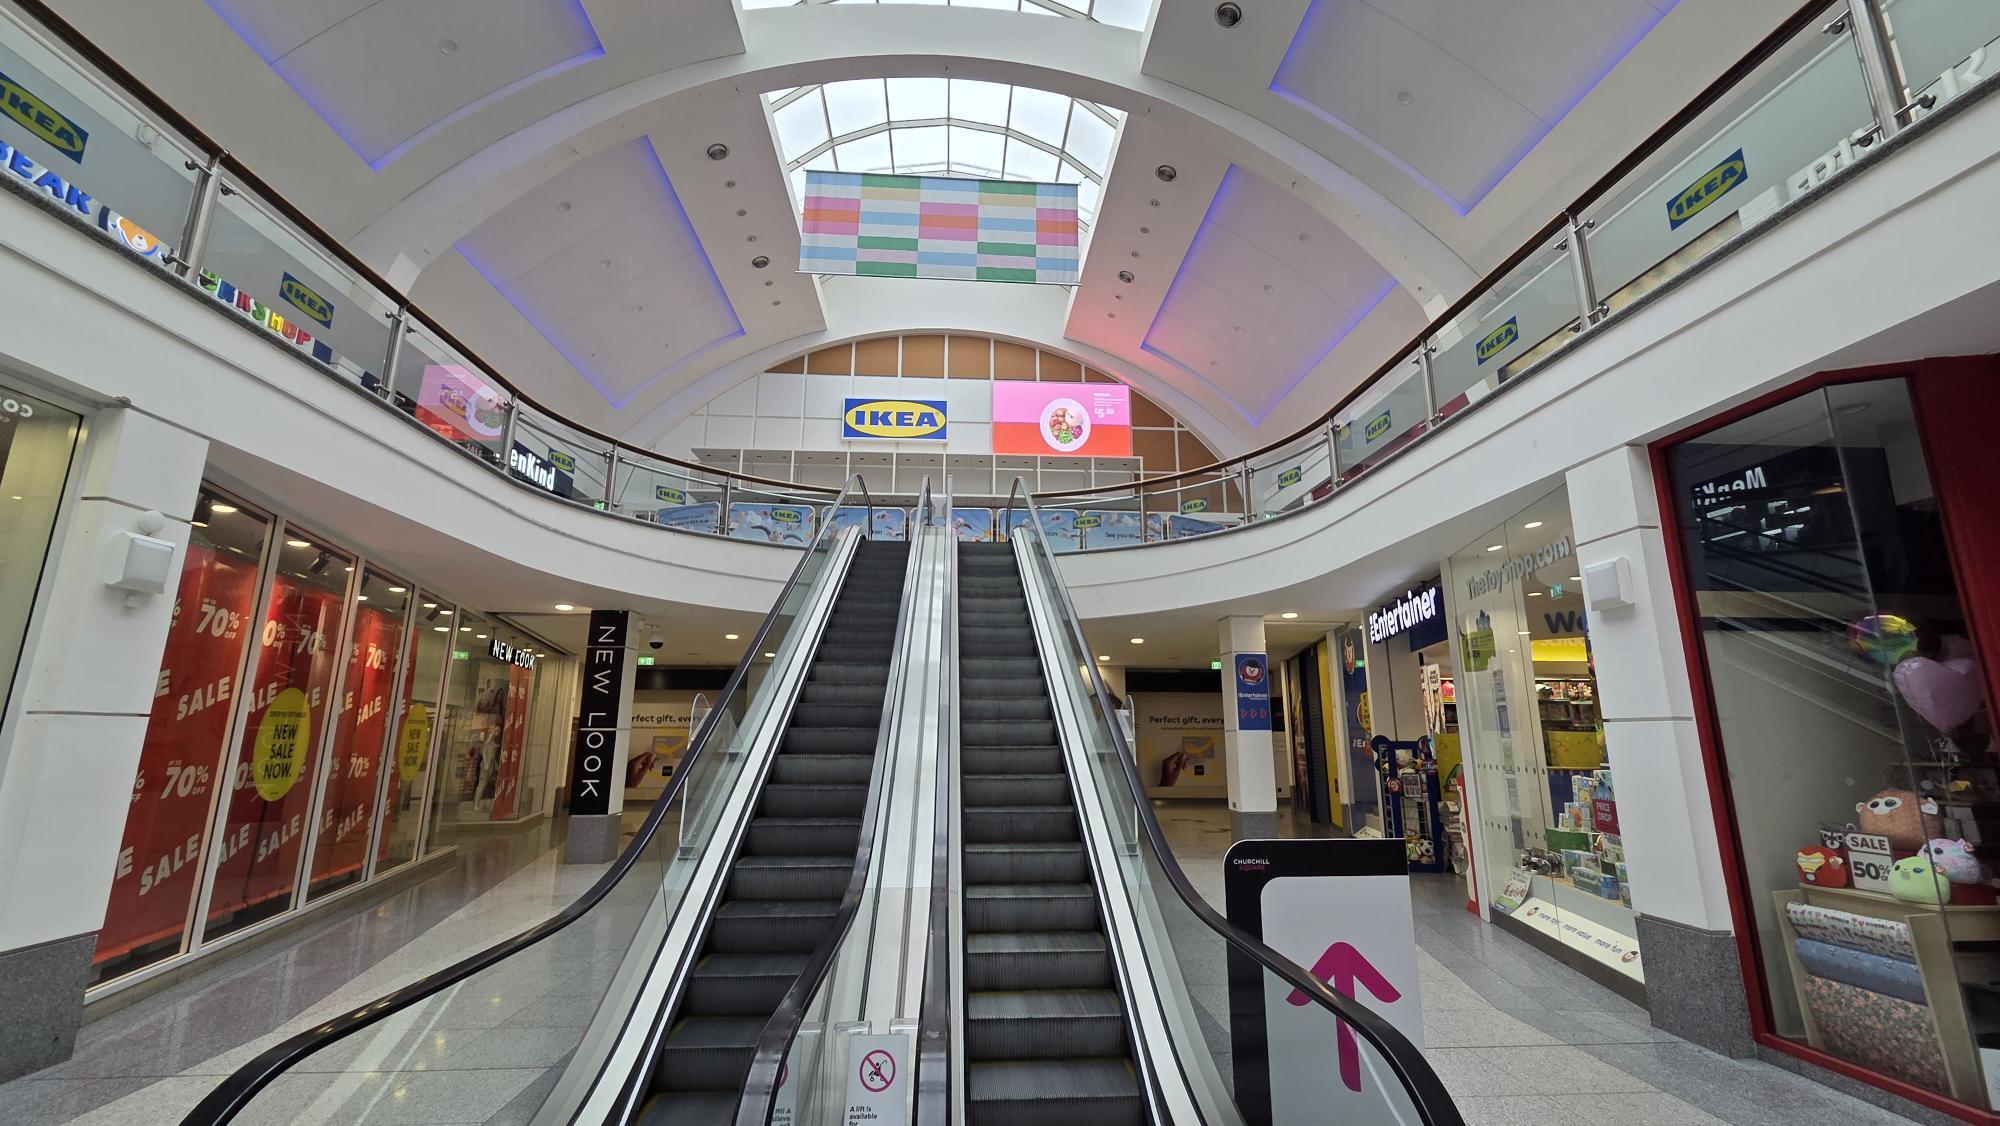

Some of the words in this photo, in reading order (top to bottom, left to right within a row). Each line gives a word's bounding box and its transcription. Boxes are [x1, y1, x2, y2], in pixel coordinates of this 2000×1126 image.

[1674, 167, 1739, 218] IKEA
[286, 282, 328, 319] IKEA
[1480, 323, 1516, 356] IKEA
[854, 410, 938, 427] IKEA
[1367, 416, 1390, 438] IKEA
[495, 447, 556, 492] enKind
[551, 453, 573, 470] IKEA
[1280, 470, 1300, 484] IKEA
[659, 489, 684, 503] IKEA
[1182, 501, 1206, 513] IKEA
[774, 511, 800, 522] IKEA
[1076, 517, 1099, 527] IKEA
[196, 604, 240, 638] 70%
[1373, 586, 1436, 642] Entertainer
[493, 639, 513, 662] NEW
[515, 650, 536, 670] LOOK
[592, 625, 616, 694] NEW
[177, 675, 230, 721] SALE
[1149, 715, 1180, 724] Perfect
[273, 724, 298, 741] NEW
[409, 728, 421, 739] NEW
[269, 743, 294, 760] SALE
[406, 743, 420, 754] SALE
[580, 712, 607, 798] LOOK
[348, 756, 370, 779] 70%
[160, 765, 209, 800] 70%
[192, 786, 207, 796] OFF
[336, 803, 364, 843] SALE
[218, 823, 250, 869] ALE
[257, 814, 300, 864] SALE
[1850, 836, 1888, 851] SALE
[139, 833, 200, 896] SALE
[1853, 860, 1891, 881] 50%
[1594, 938, 1611, 949] more
[1610, 944, 1623, 954] fun
